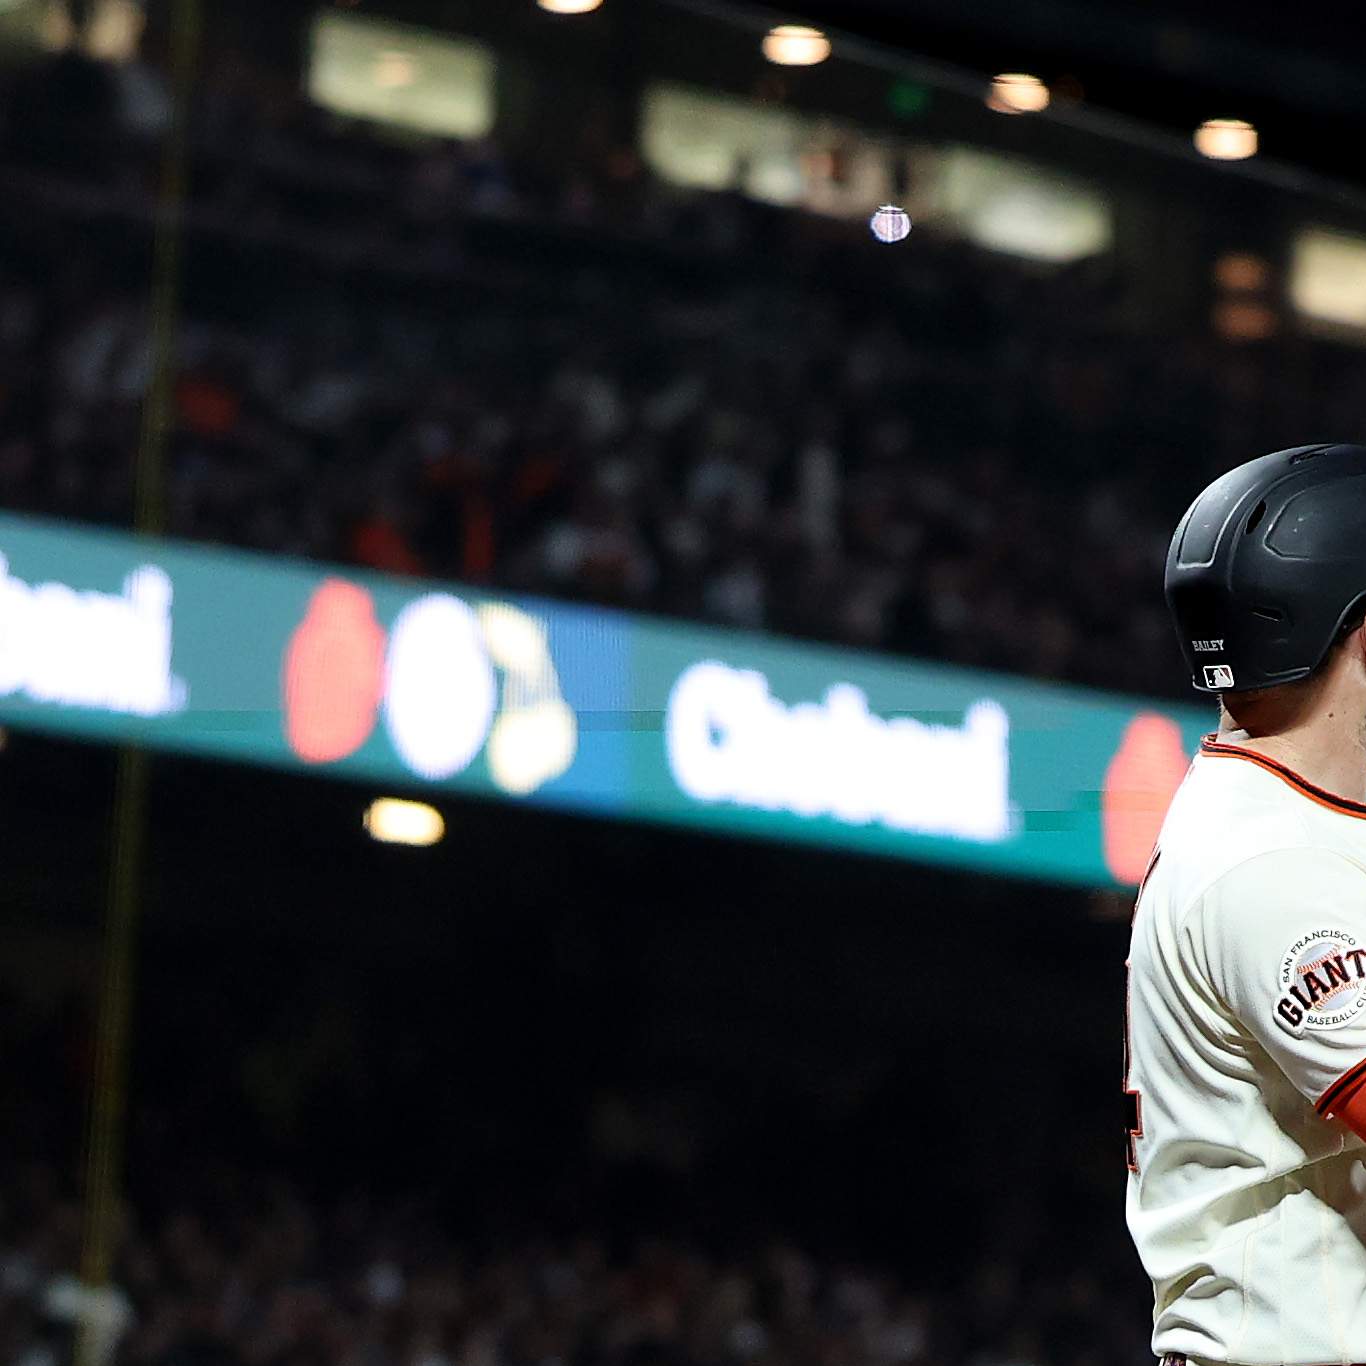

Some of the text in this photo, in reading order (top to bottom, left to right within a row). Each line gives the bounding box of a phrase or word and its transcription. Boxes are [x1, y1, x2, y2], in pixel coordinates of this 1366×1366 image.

[1191, 639, 1224, 651] BAILEY
[1282, 929, 1357, 983] SAN FRANCISCO
[1306, 1009, 1358, 1025] BASEBALL
